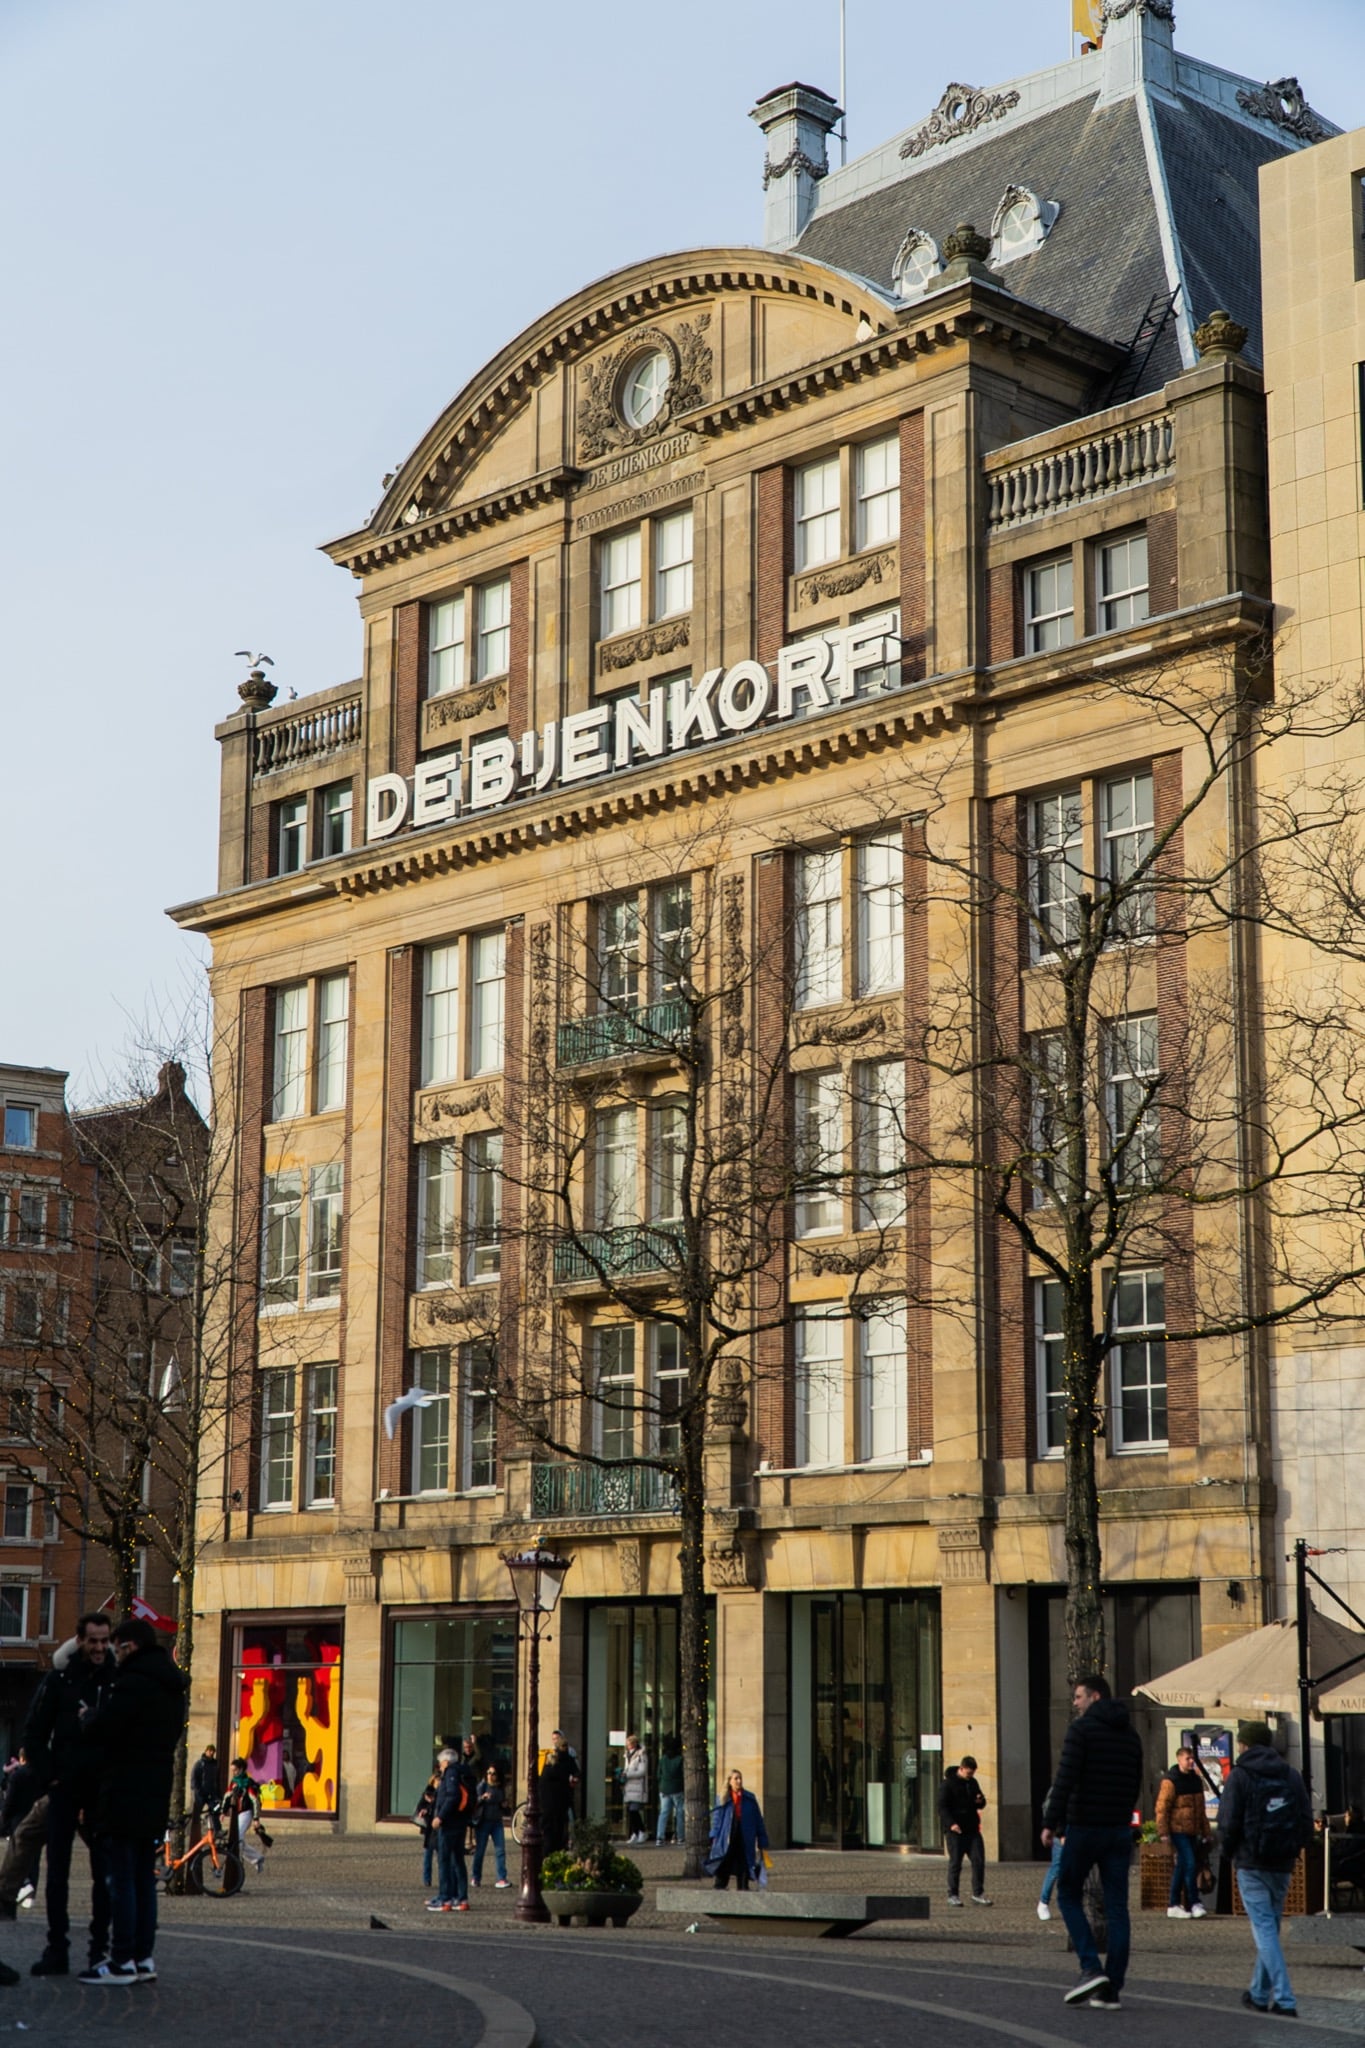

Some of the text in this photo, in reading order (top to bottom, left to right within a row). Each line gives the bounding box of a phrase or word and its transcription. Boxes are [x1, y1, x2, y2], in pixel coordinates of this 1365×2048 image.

[588, 468, 607, 491] DE
[368, 613, 897, 840] DE BIJENKORF
